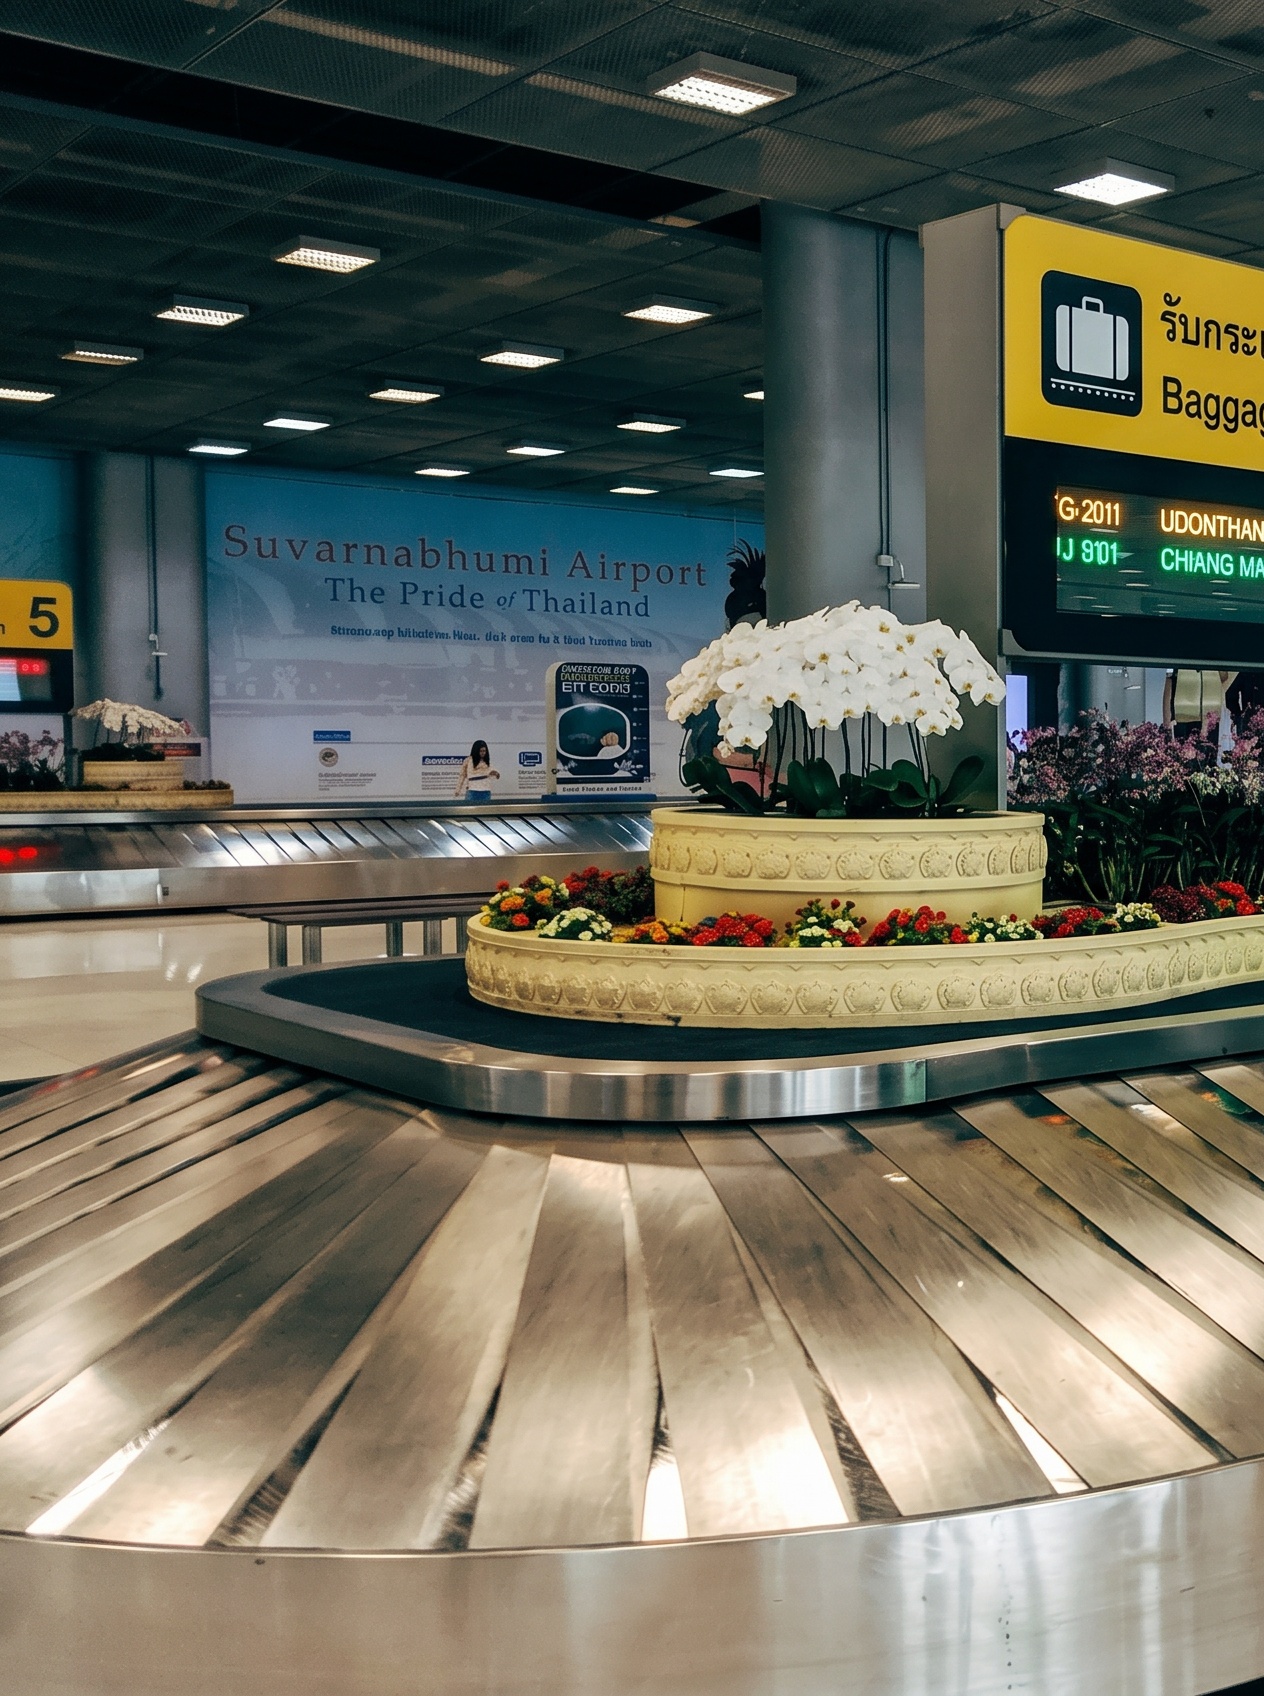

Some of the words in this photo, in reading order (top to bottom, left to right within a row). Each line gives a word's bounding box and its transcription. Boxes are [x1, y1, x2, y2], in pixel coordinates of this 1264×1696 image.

[1081, 499, 1119, 526] 2011
[223, 524, 549, 577] Suvarnabhumi
[566, 549, 707, 592] Airport
[1160, 547, 1234, 576] CHIANG
[29, 596, 59, 638] 5
[324, 577, 386, 604] The
[399, 581, 485, 609] Pride
[496, 590, 517, 610] of
[522, 588, 650, 617] Thailand
